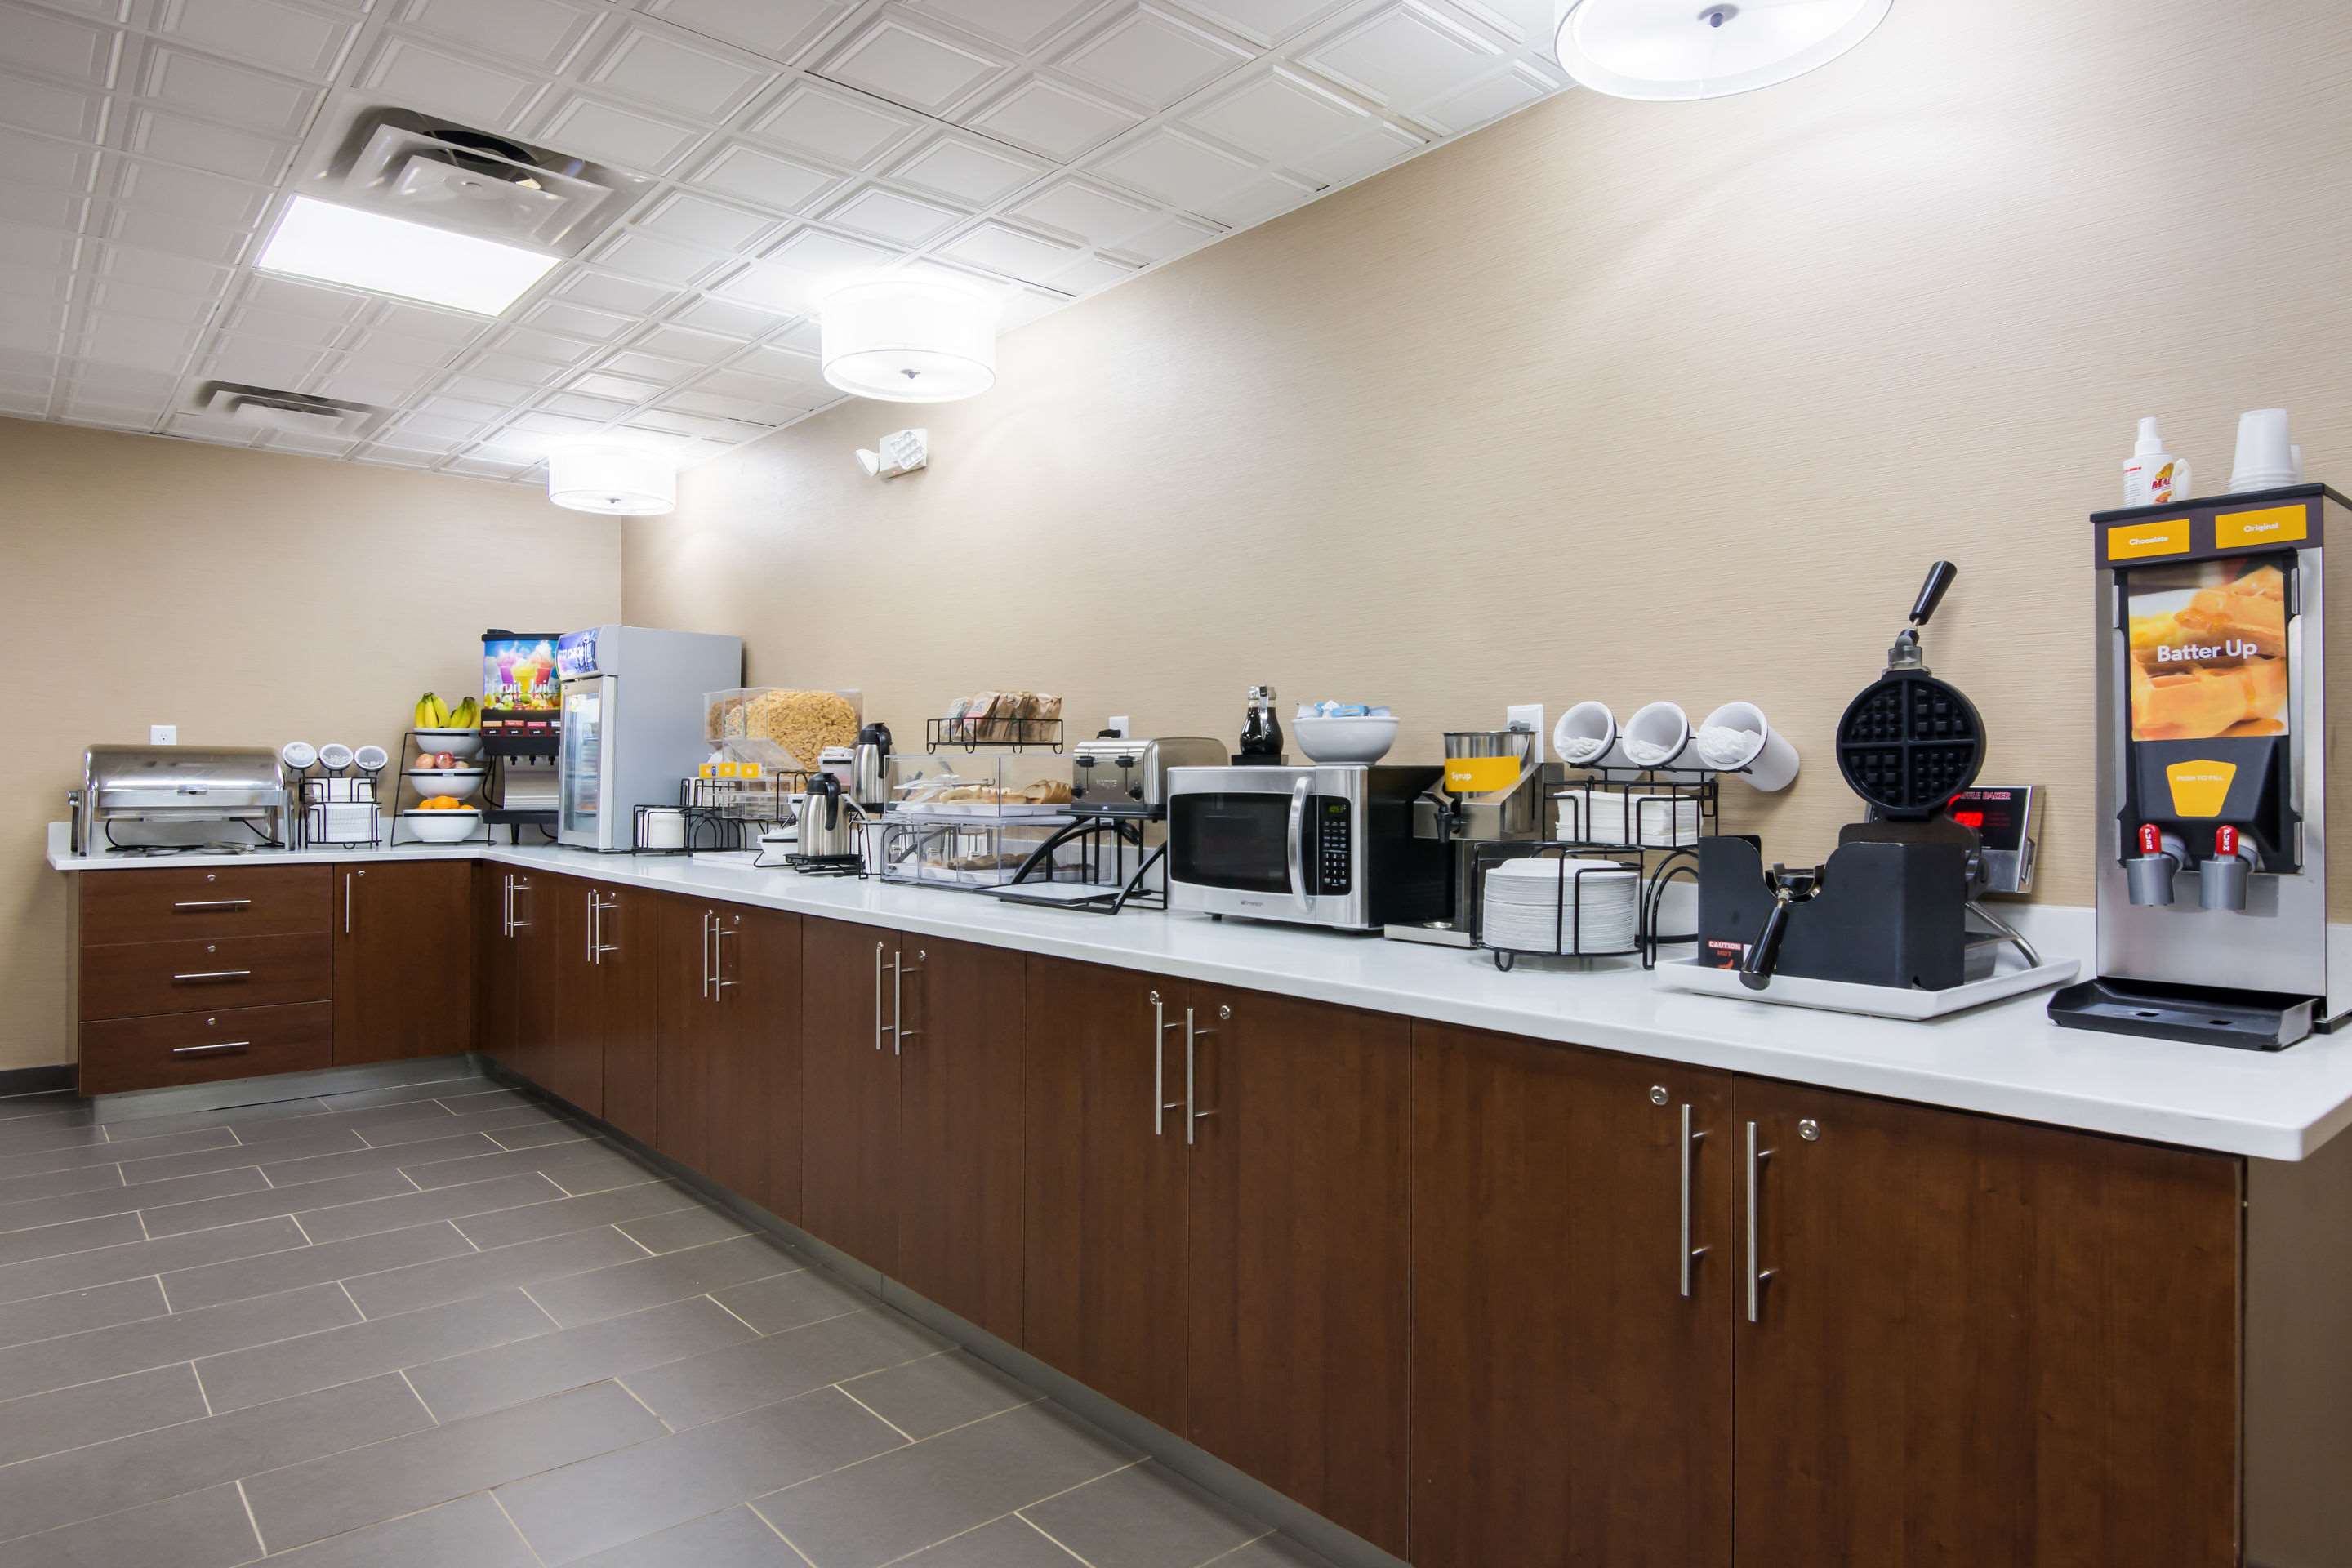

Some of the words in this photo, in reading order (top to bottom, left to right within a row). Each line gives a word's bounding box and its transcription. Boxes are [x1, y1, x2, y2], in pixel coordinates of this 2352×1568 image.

[2243, 522, 2279, 532] Original
[2129, 536, 2169, 545] Chocolate
[2157, 644, 2221, 662] Batter
[2225, 639, 2258, 660] Up
[1451, 771, 1472, 782] Syrup
[1982, 791, 2011, 800] BAKER
[2144, 828, 2154, 850] PUSH
[2222, 829, 2231, 852] PUSH
[1708, 940, 1742, 951] CAUTION
